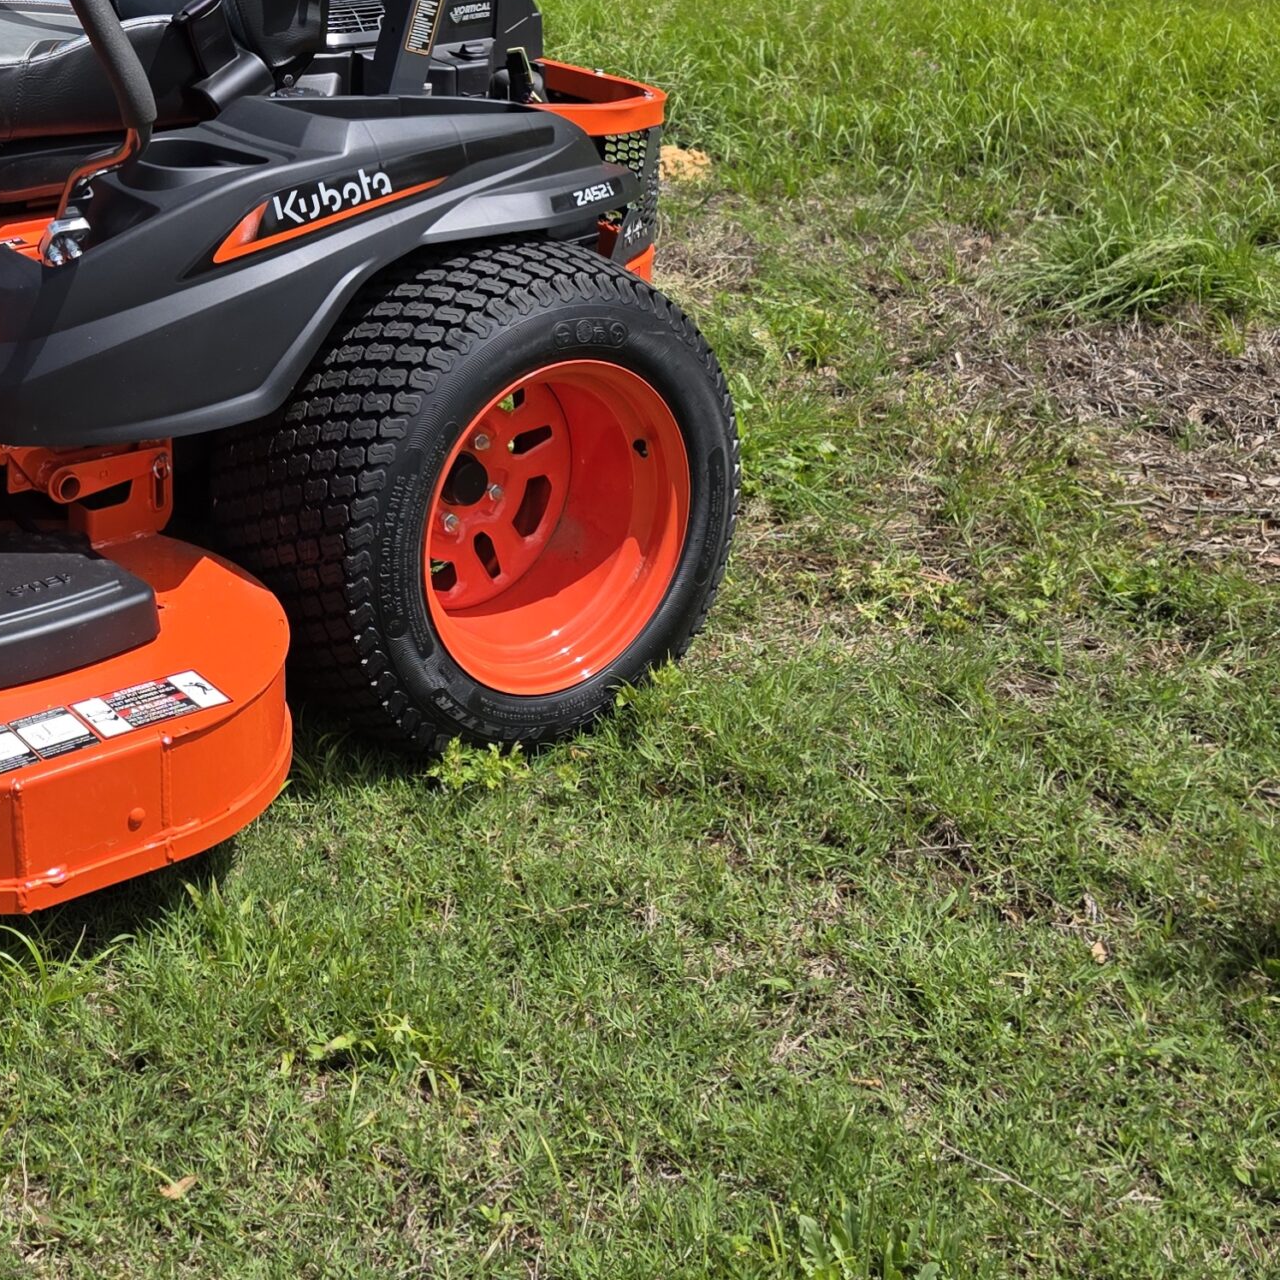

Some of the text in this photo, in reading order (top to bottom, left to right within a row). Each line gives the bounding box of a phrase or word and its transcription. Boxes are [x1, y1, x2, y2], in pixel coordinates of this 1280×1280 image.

[453, 2, 491, 16] VORTICAL
[272, 168, 393, 224] Kubota
[573, 182, 615, 206] Z452i
